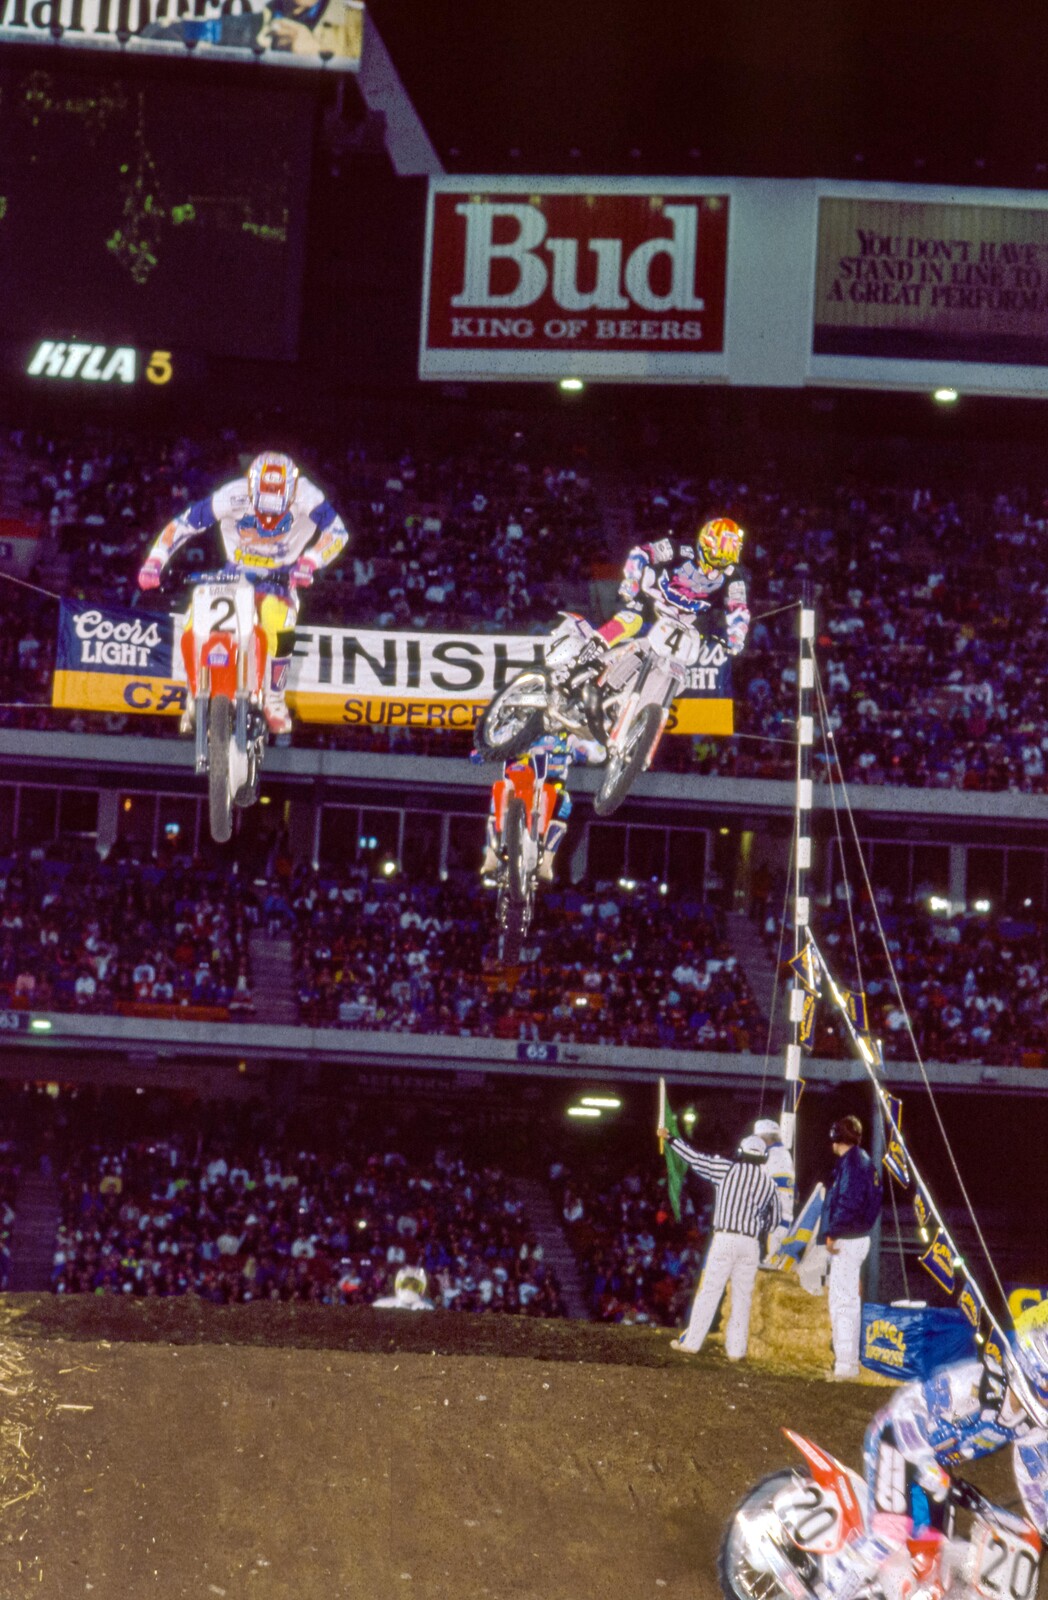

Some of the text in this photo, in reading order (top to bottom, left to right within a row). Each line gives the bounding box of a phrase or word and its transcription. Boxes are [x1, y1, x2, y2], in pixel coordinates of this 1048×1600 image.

[451, 202, 705, 312] Bud
[839, 256, 914, 282] STAND
[919, 260, 943, 284] IN
[952, 262, 1003, 289] LINE
[828, 279, 1048, 313] A GREAT PERFORM
[451, 317, 703, 341] KING OF BEERS
[26, 341, 173, 386] KTLA 5
[73, 610, 161, 648] Coors
[210, 597, 236, 634] 2
[81, 640, 151, 667] LIGHT
[664, 628, 685, 655] 4
[866, 1319, 906, 1352] CAMEL
[775, 1486, 838, 1544] 20
[980, 1537, 1036, 1600] 20
